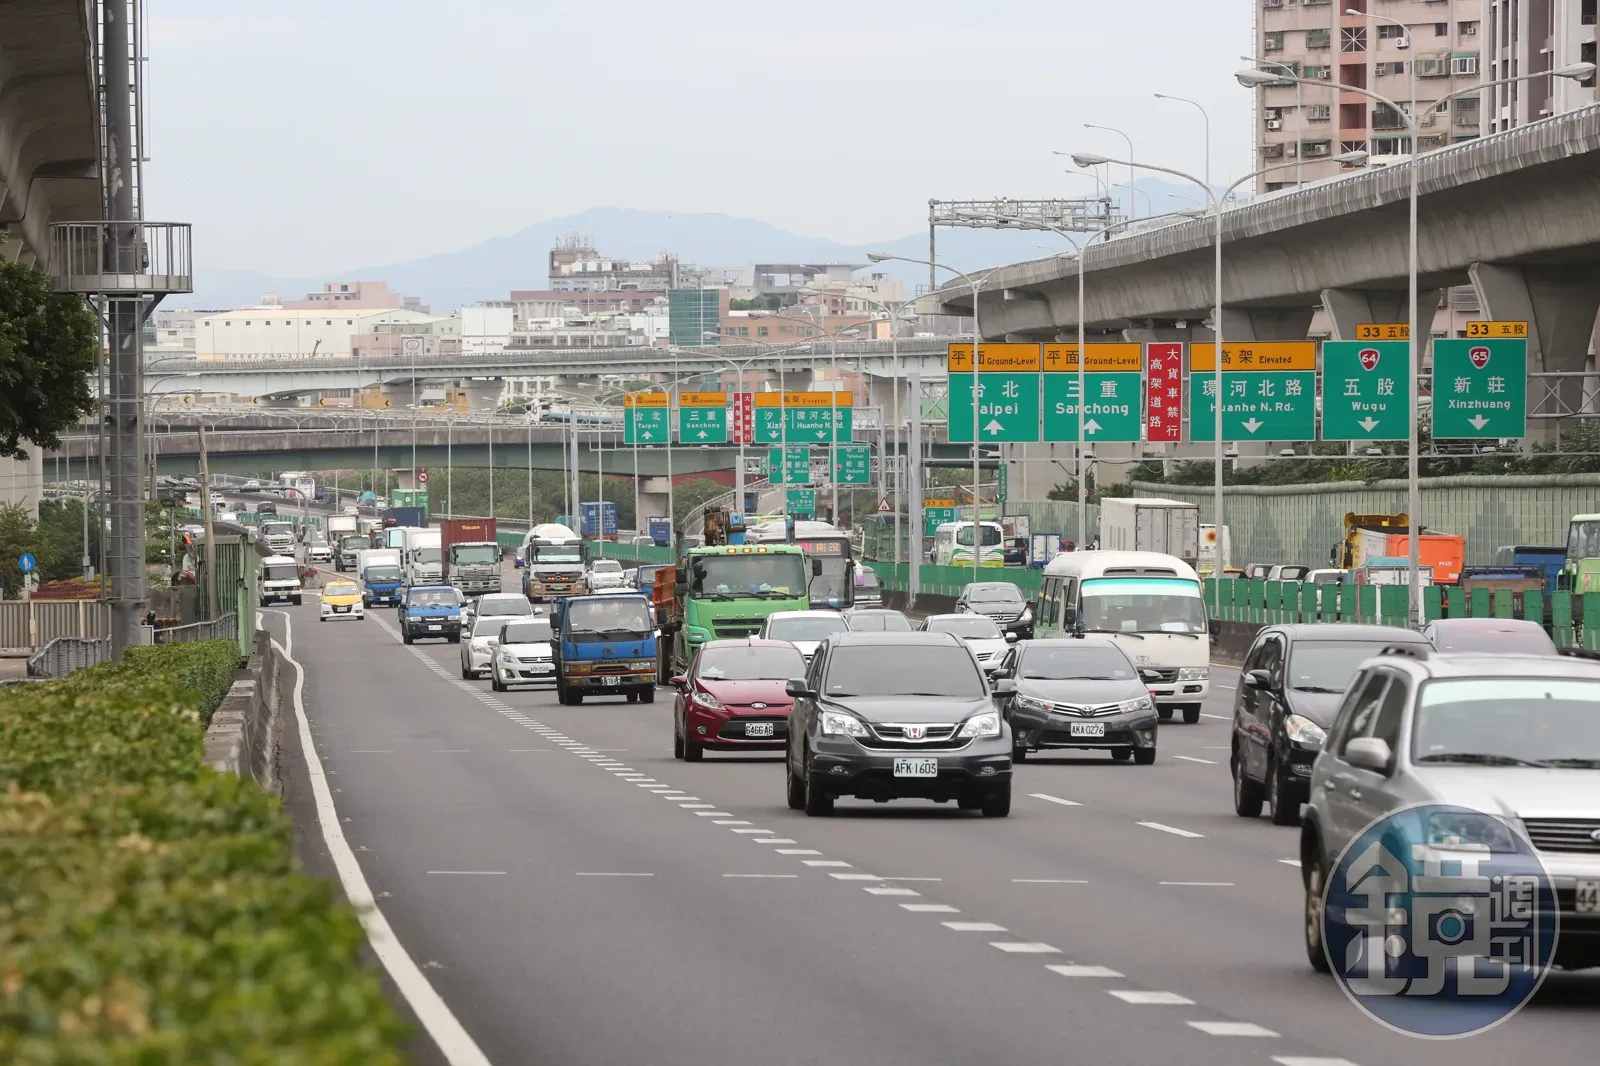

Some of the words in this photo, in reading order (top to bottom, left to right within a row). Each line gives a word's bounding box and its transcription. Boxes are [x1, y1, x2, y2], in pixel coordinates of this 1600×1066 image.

[1363, 327, 1380, 338] 33
[1388, 326, 1410, 338] 五股
[1471, 324, 1489, 335] 33
[1501, 324, 1524, 335] 五股
[952, 350, 985, 365] 平面
[987, 357, 1036, 365] Ground-Level
[1047, 350, 1080, 365] 平面
[1084, 357, 1138, 365] Ground-Level
[1221, 349, 1253, 364] 高架
[1259, 355, 1292, 364] Elevated
[1361, 353, 1377, 363] 64
[1472, 351, 1487, 361] 65
[969, 380, 1019, 398] 台北
[1066, 380, 1118, 398] 三重
[1167, 348, 1179, 437] 大貨車禁行
[1203, 379, 1303, 397] 環河北路
[1343, 378, 1395, 396] 五股
[1454, 376, 1505, 394] 新莊
[1150, 358, 1162, 428] 高架道路
[1260, 402, 1273, 412] N.
[1275, 402, 1294, 412] Rd.
[1352, 401, 1386, 412] Wugu
[1448, 399, 1511, 411] Xinzhuang
[690, 411, 717, 421] 三重
[928, 509, 951, 518] 出口
